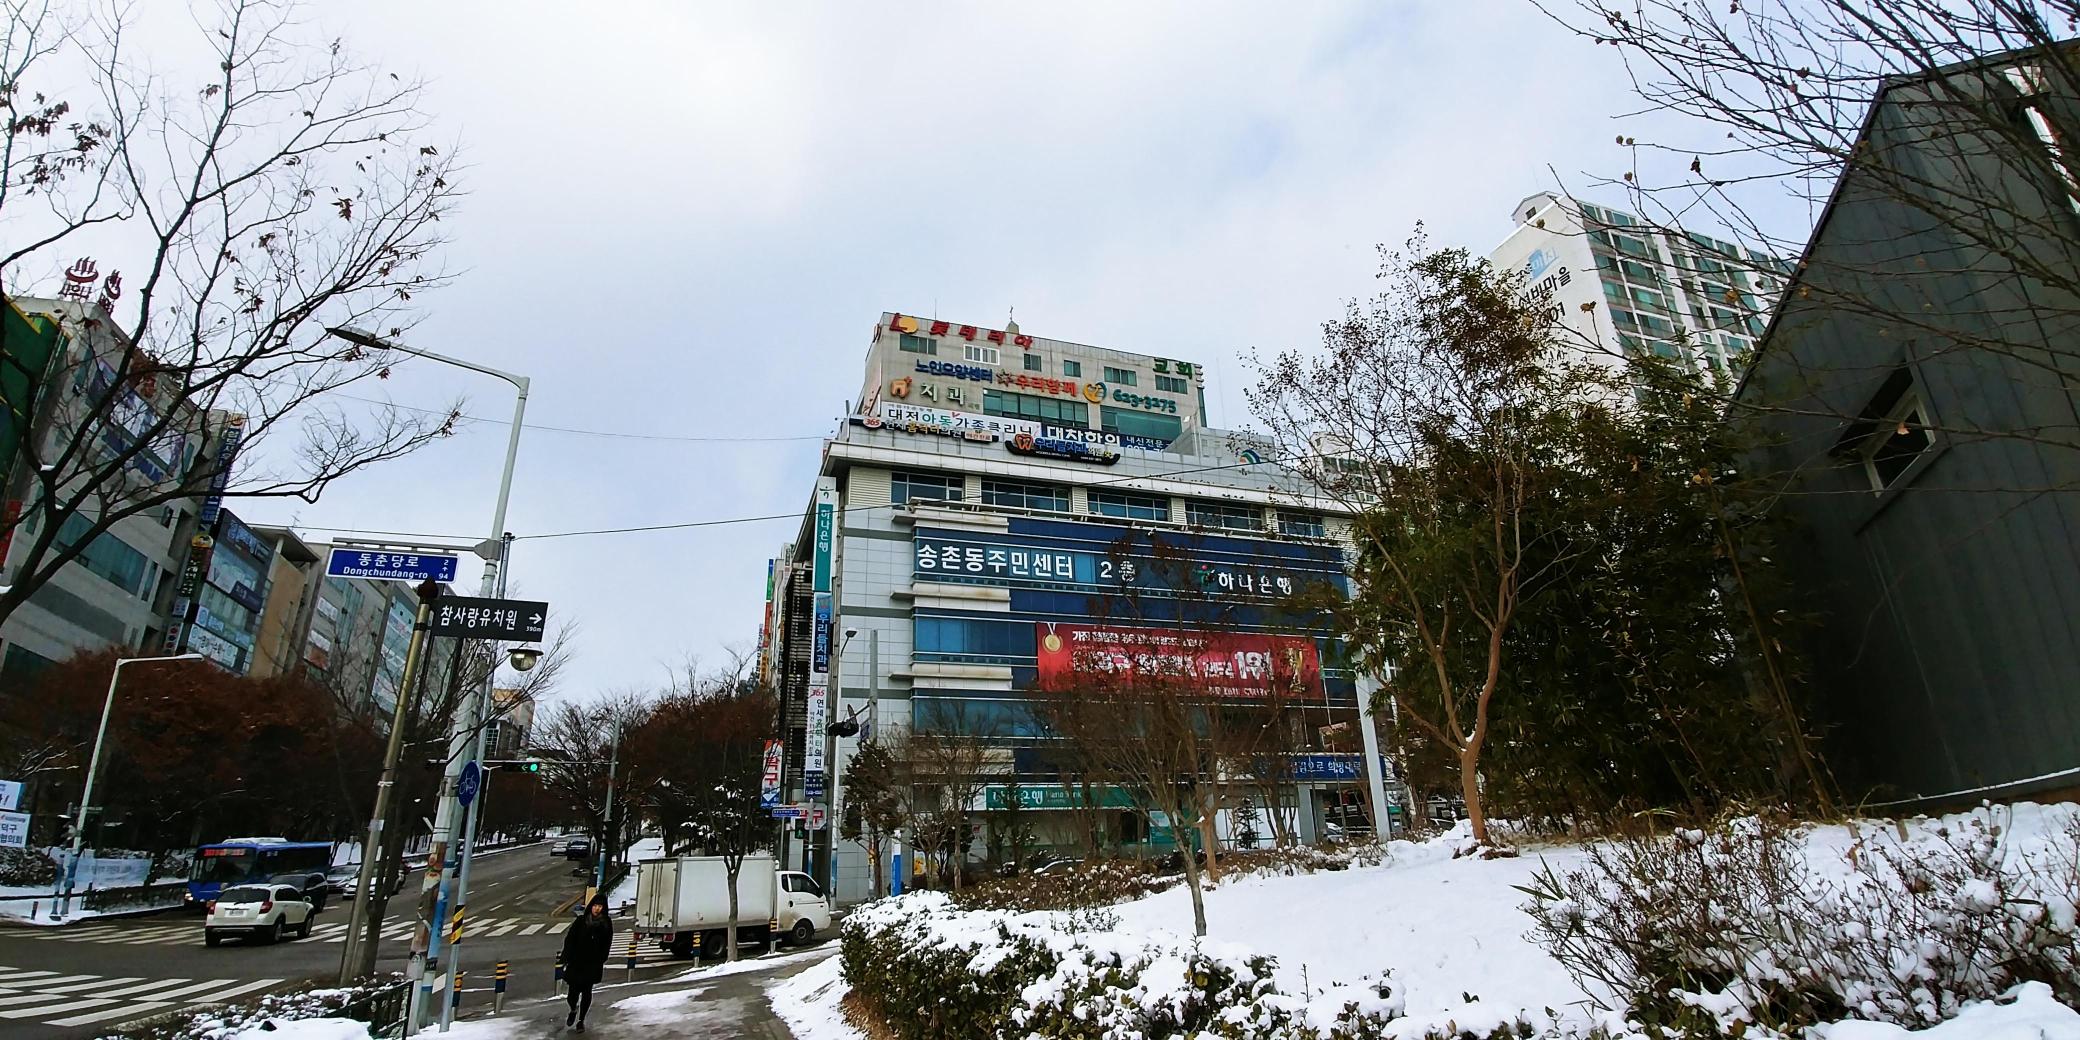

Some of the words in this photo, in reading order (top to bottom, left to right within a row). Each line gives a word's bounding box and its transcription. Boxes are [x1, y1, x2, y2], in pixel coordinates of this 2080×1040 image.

[929, 320, 1033, 350] 롯데리아
[915, 359, 993, 383] 노인요양센터
[1015, 374, 1077, 397] 우리함께
[1153, 358, 1193, 380] 교회
[920, 383, 966, 405] 치과
[1112, 389, 1177, 413] 623-3275
[865, 418, 880, 427] 365
[819, 509, 831, 552] 하나은행
[358, 553, 419, 568] 동춘당로
[917, 544, 1073, 579] 송촌동주민센터
[343, 566, 428, 580] Dongchundang-ro
[1217, 571, 1292, 595] 하나은행
[440, 605, 518, 631] 참사랑유치원
[816, 613, 829, 665] 우리들치과
